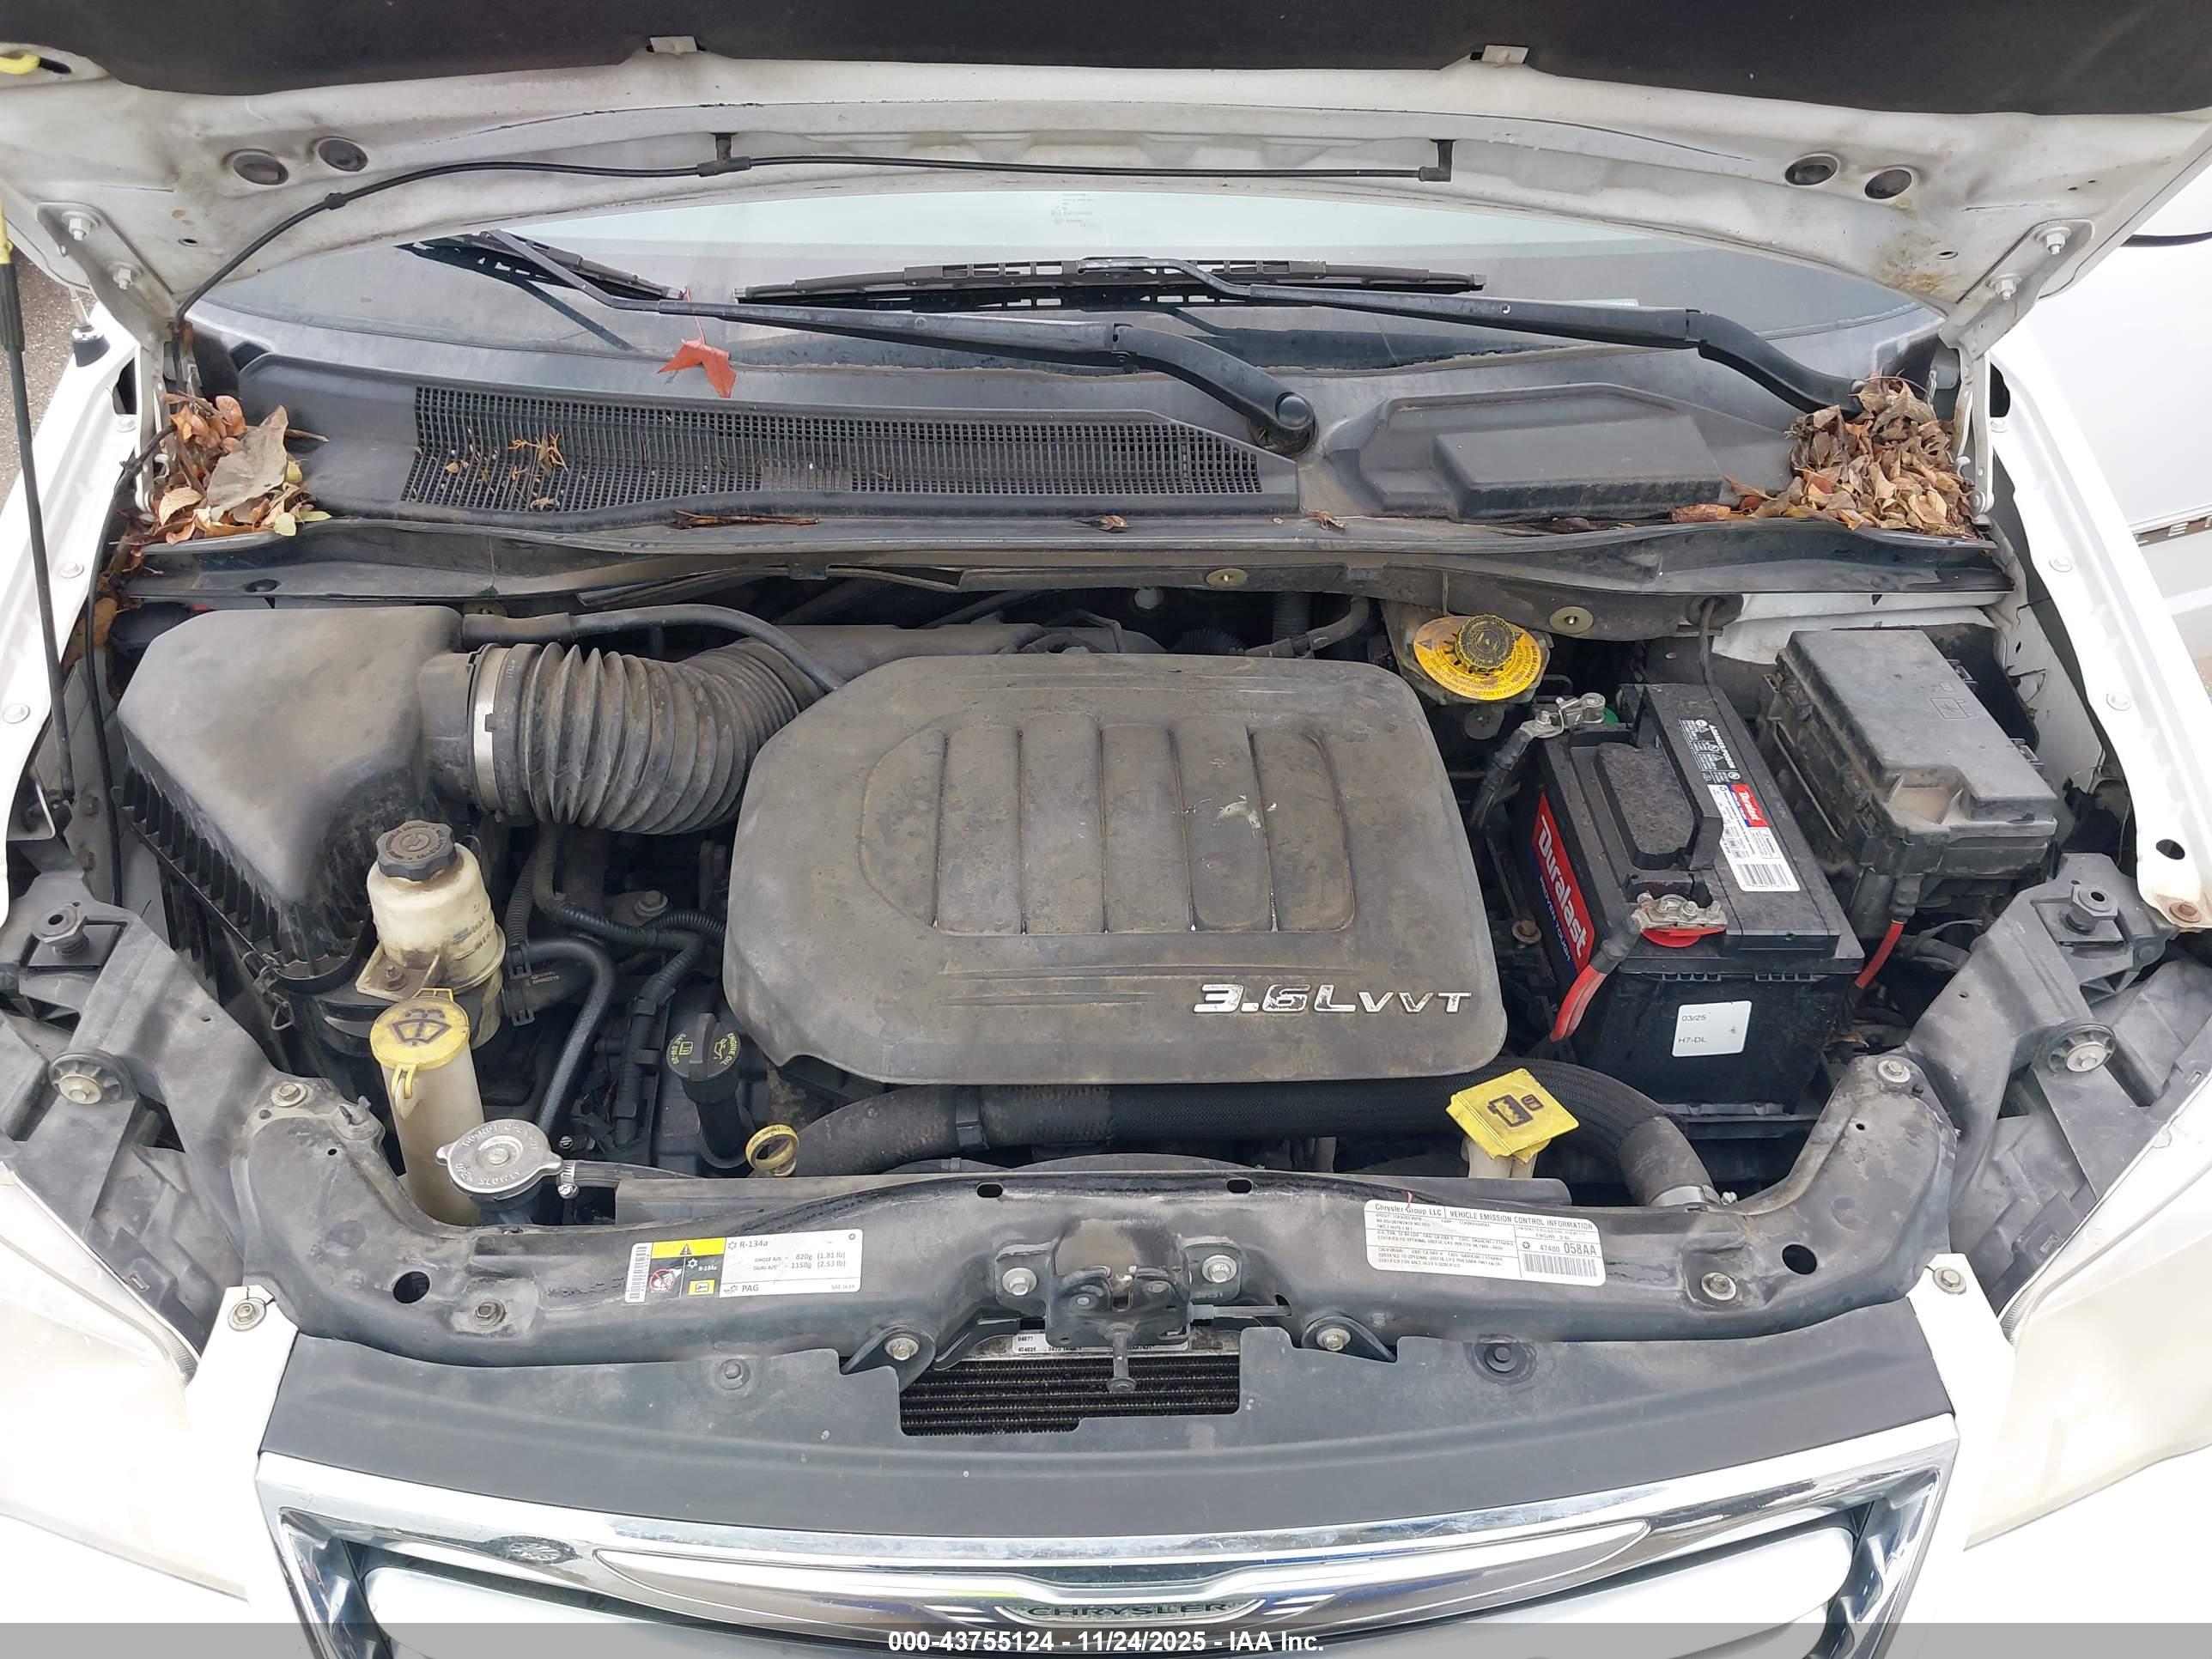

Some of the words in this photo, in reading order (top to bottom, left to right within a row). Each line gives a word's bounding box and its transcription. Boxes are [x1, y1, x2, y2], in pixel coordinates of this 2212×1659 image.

[1538, 814, 1588, 959] Duralast
[1556, 921, 1571, 962] TOUGH
[673, 1033, 687, 1045] SAE
[727, 1032, 738, 1055] ENGINE
[720, 1055, 732, 1066] OIL
[455, 1163, 473, 1182] OPEN
[478, 1169, 522, 1186] SLOWLY
[1375, 1204, 1404, 1213] Chrysler
[1406, 1206, 1426, 1215] Group
[1449, 1210, 1478, 1220] VEHICLE
[1480, 1212, 1512, 1223] EMISSION
[1514, 1216, 1544, 1226] CONTROL
[1547, 1219, 1593, 1231] INFORMATION
[739, 1240, 769, 1249] R-134a
[1564, 1243, 1597, 1255] 058AA
[1028, 1603, 1228, 1618] CHRYSLER
